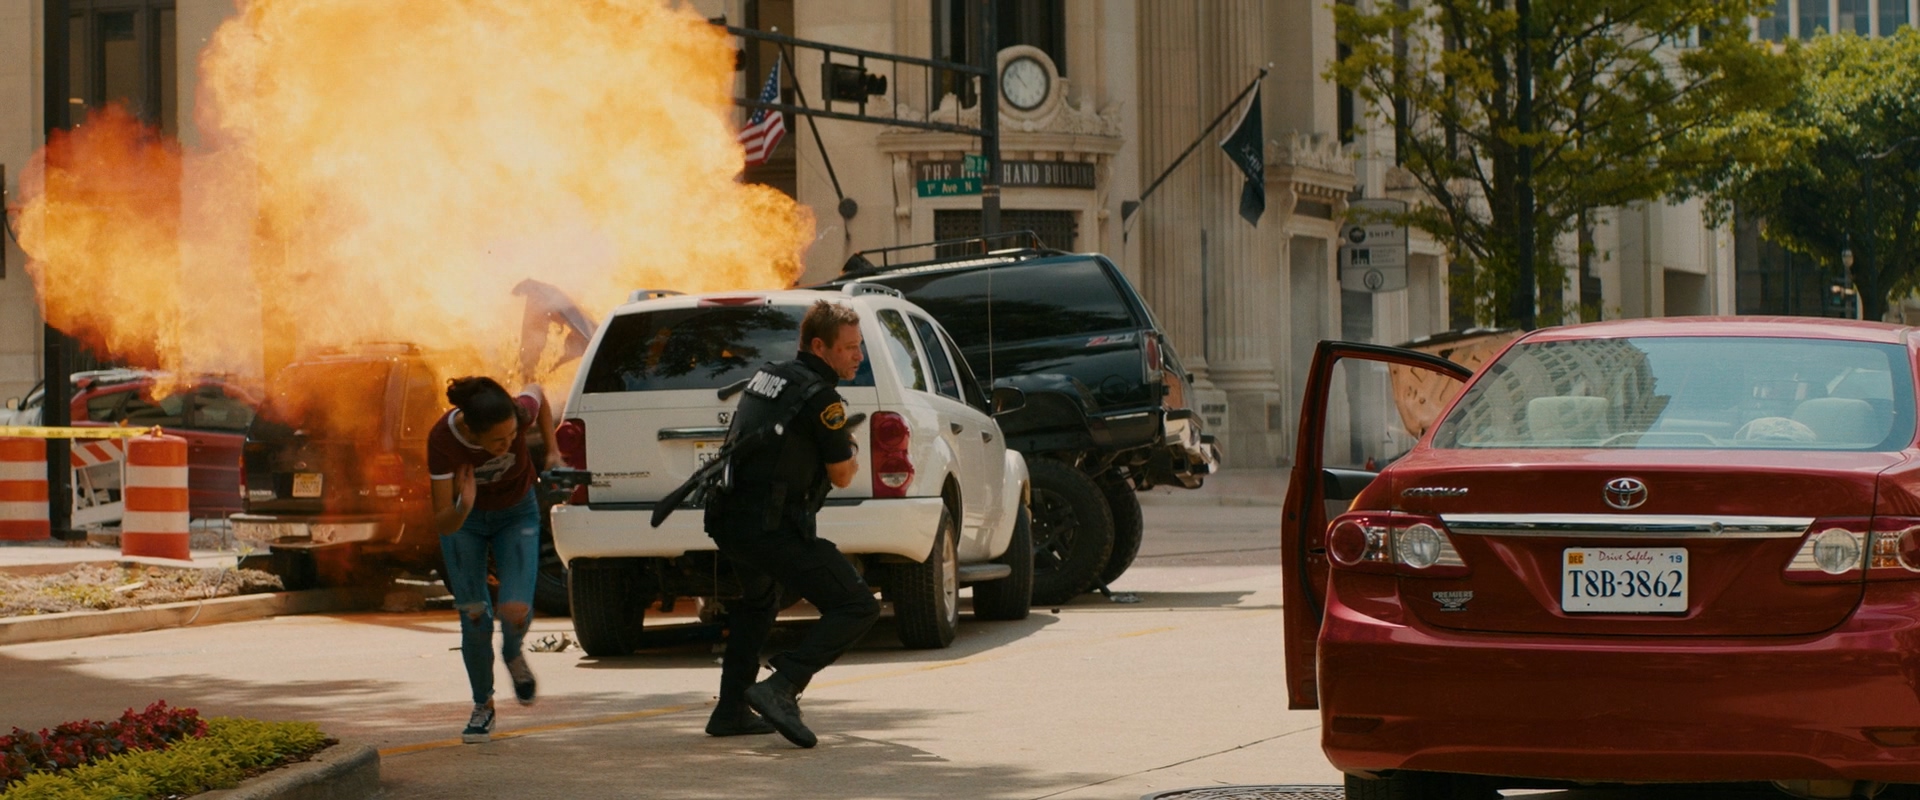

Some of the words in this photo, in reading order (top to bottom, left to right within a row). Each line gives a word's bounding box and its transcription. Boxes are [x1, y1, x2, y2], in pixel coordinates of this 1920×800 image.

[1003, 164, 1039, 184] HAND
[1045, 165, 1094, 187] BUILDING
[941, 183, 958, 193] Ave
[965, 181, 973, 192] N
[747, 370, 788, 399] POLICE
[1401, 487, 1469, 497] COROLLA
[1598, 550, 1623, 562] Drive
[1625, 550, 1654, 565] Safely
[1668, 555, 1683, 563] 19
[1568, 569, 1683, 598] T8B-3862
[1432, 590, 1474, 598] PREMIERE
